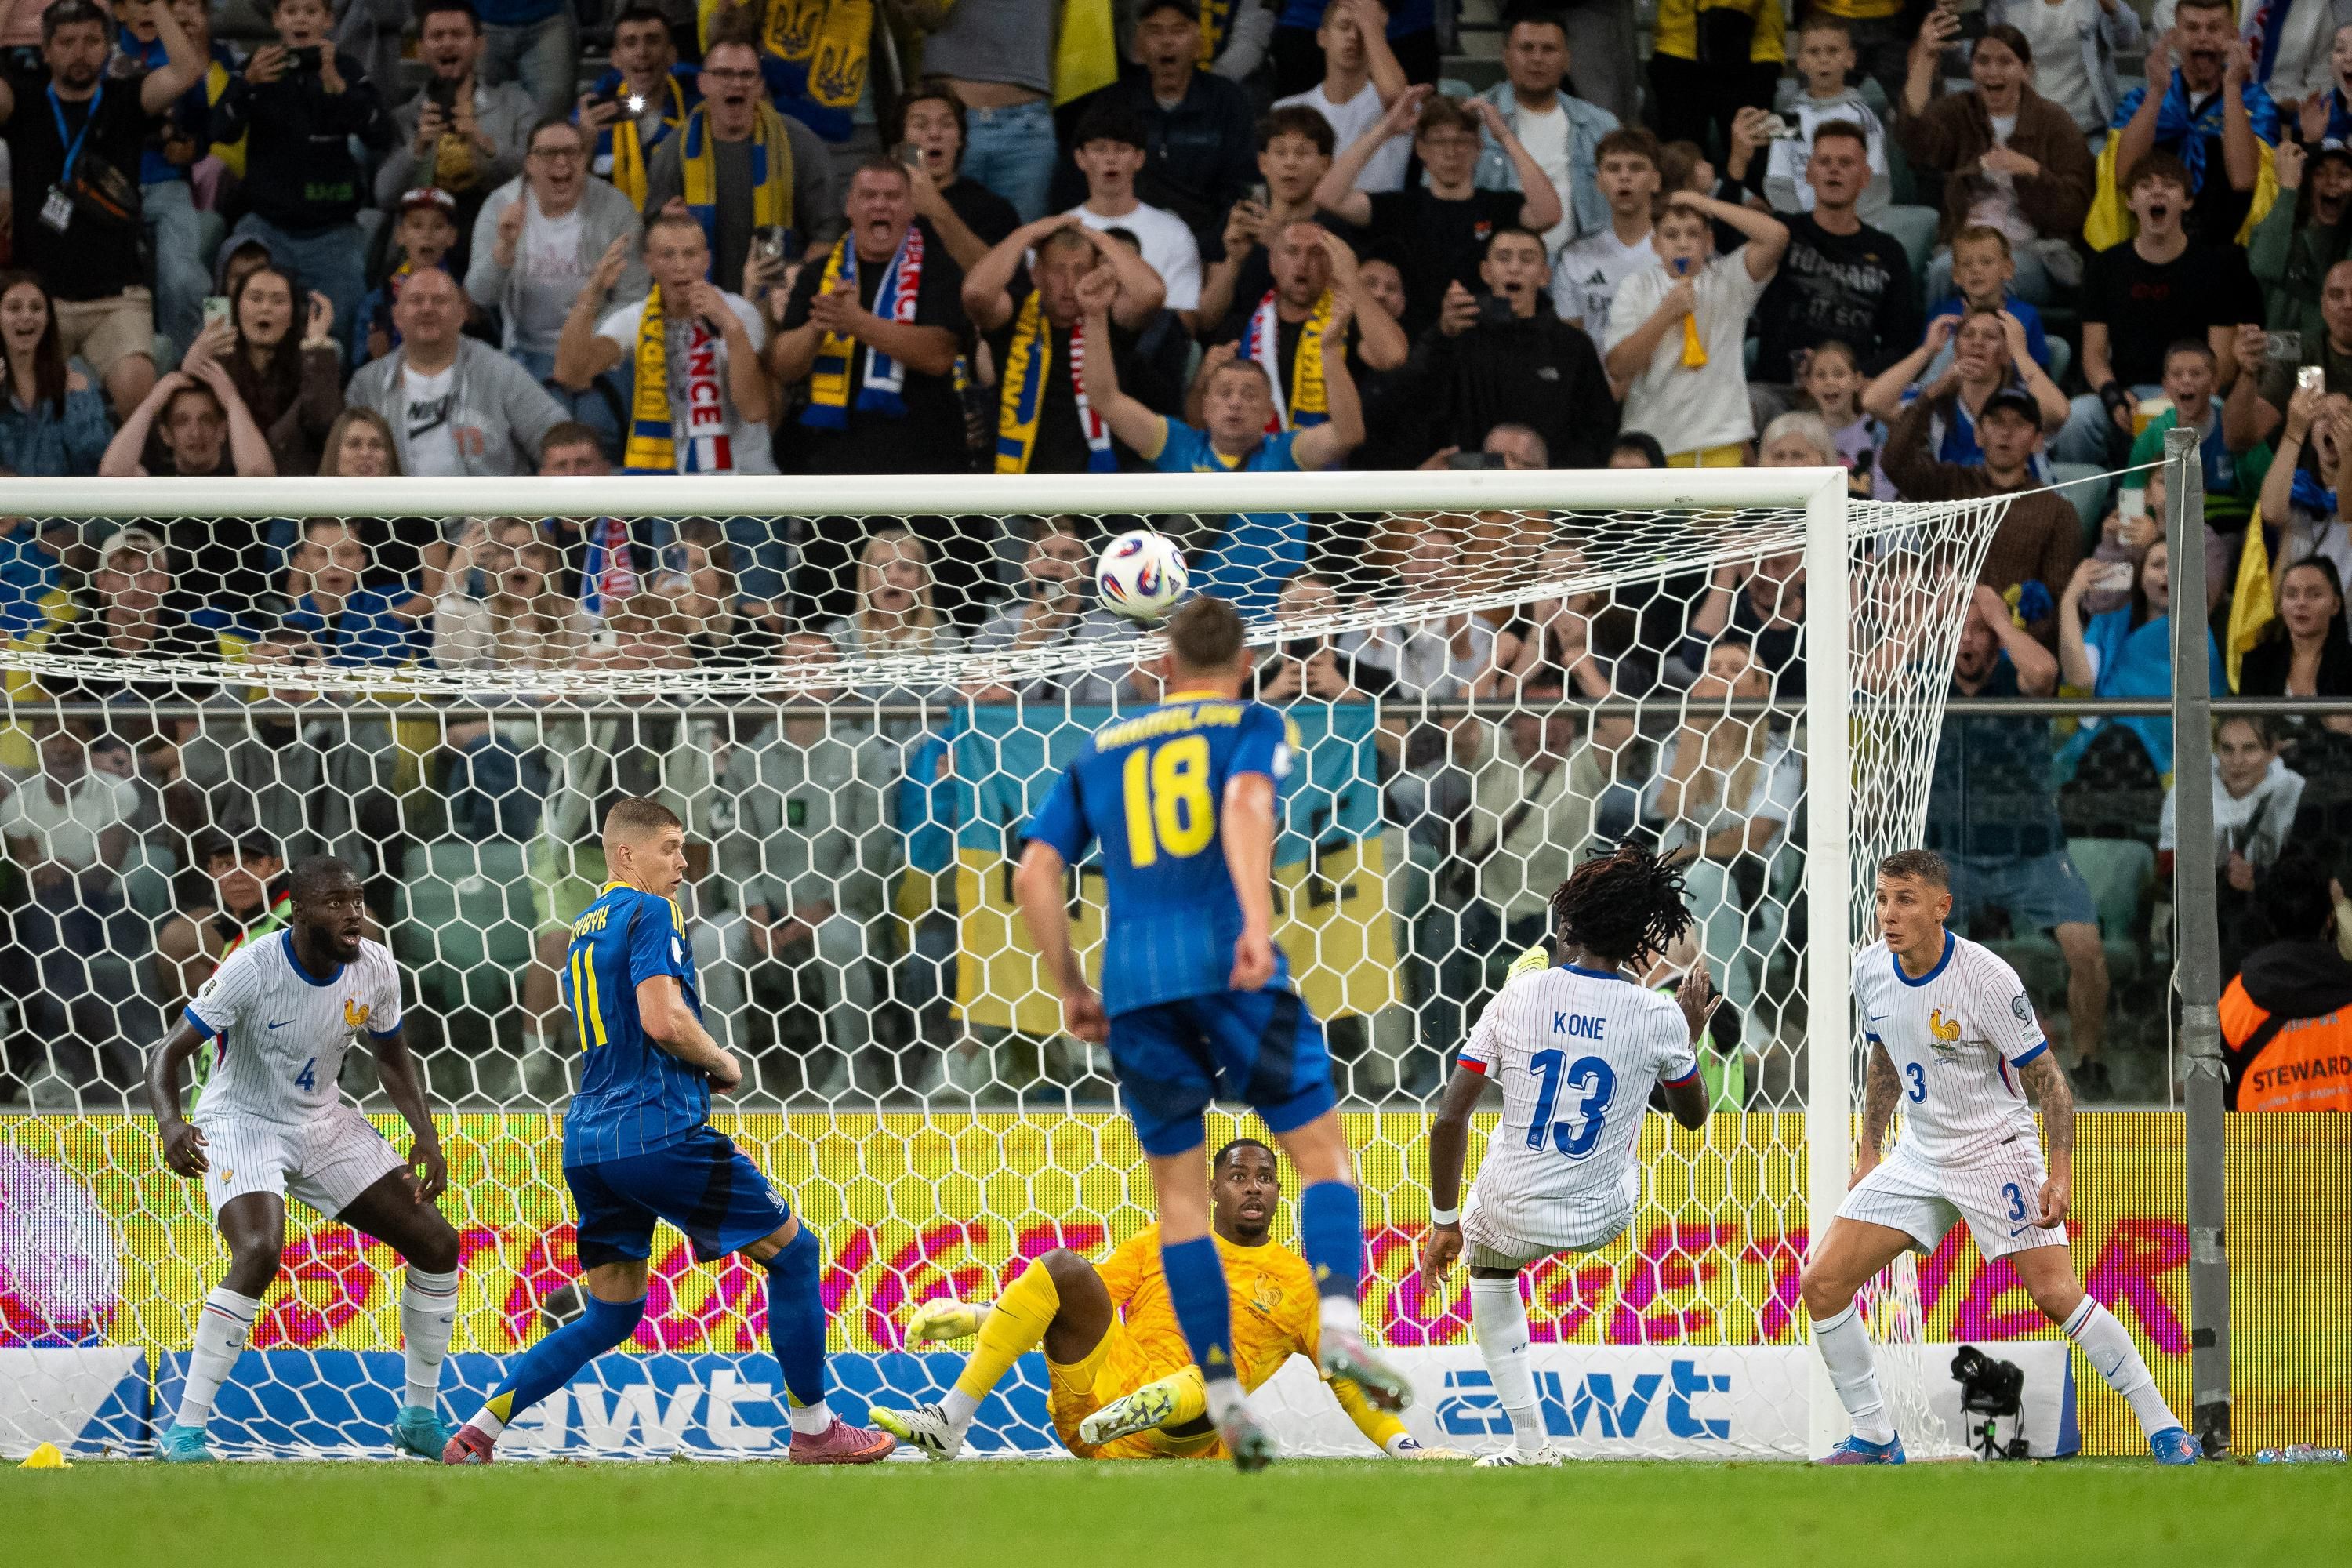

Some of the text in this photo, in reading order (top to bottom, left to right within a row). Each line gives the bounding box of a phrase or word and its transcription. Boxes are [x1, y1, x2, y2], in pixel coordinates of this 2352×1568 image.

[690, 325, 722, 427] ANCE
[1122, 735, 1215, 869] 18
[569, 904, 611, 949] OVBYK
[571, 941, 608, 1053] 11
[1554, 1011, 1606, 1040] KONE
[295, 1057, 317, 1091] 4
[1906, 1062, 1928, 1105] 3
[2252, 1054, 2352, 1093] STEWARD
[1526, 1048, 1617, 1160] 13
[2002, 1182, 2028, 1222] 3
[1435, 1359, 1731, 1440] awt
